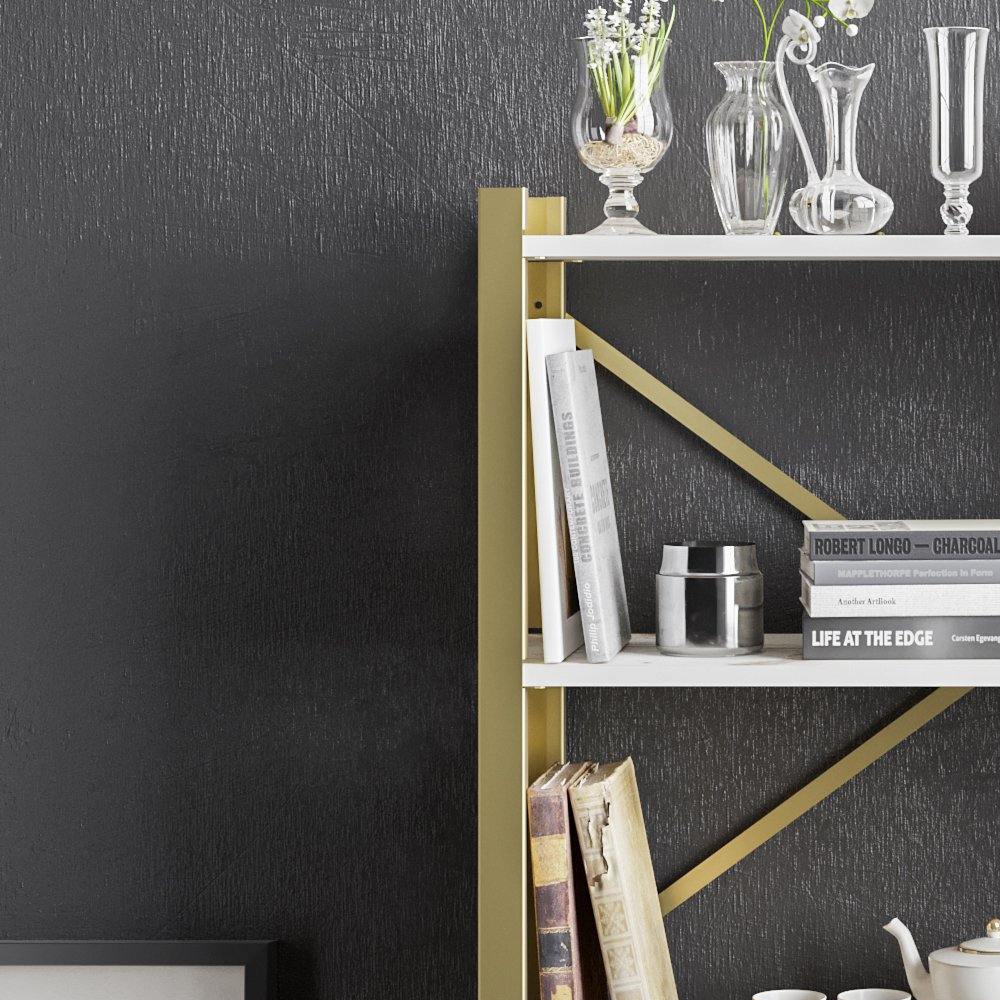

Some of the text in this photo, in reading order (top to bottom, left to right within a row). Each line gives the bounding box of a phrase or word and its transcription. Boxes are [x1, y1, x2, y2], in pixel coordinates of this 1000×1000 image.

[561, 412, 592, 563] CONCRETE BUILDINGS
[814, 537, 866, 555] ROBERT
[868, 537, 911, 555] LONGO
[837, 569, 911, 578] MAPPLETHORPE
[913, 568, 958, 577] Perfection
[971, 568, 994, 577] Form
[837, 598, 897, 606] Another ArtBook
[583, 582, 600, 652] Philip Jodidio
[811, 630, 934, 647] LIFE AT THE EDGE
